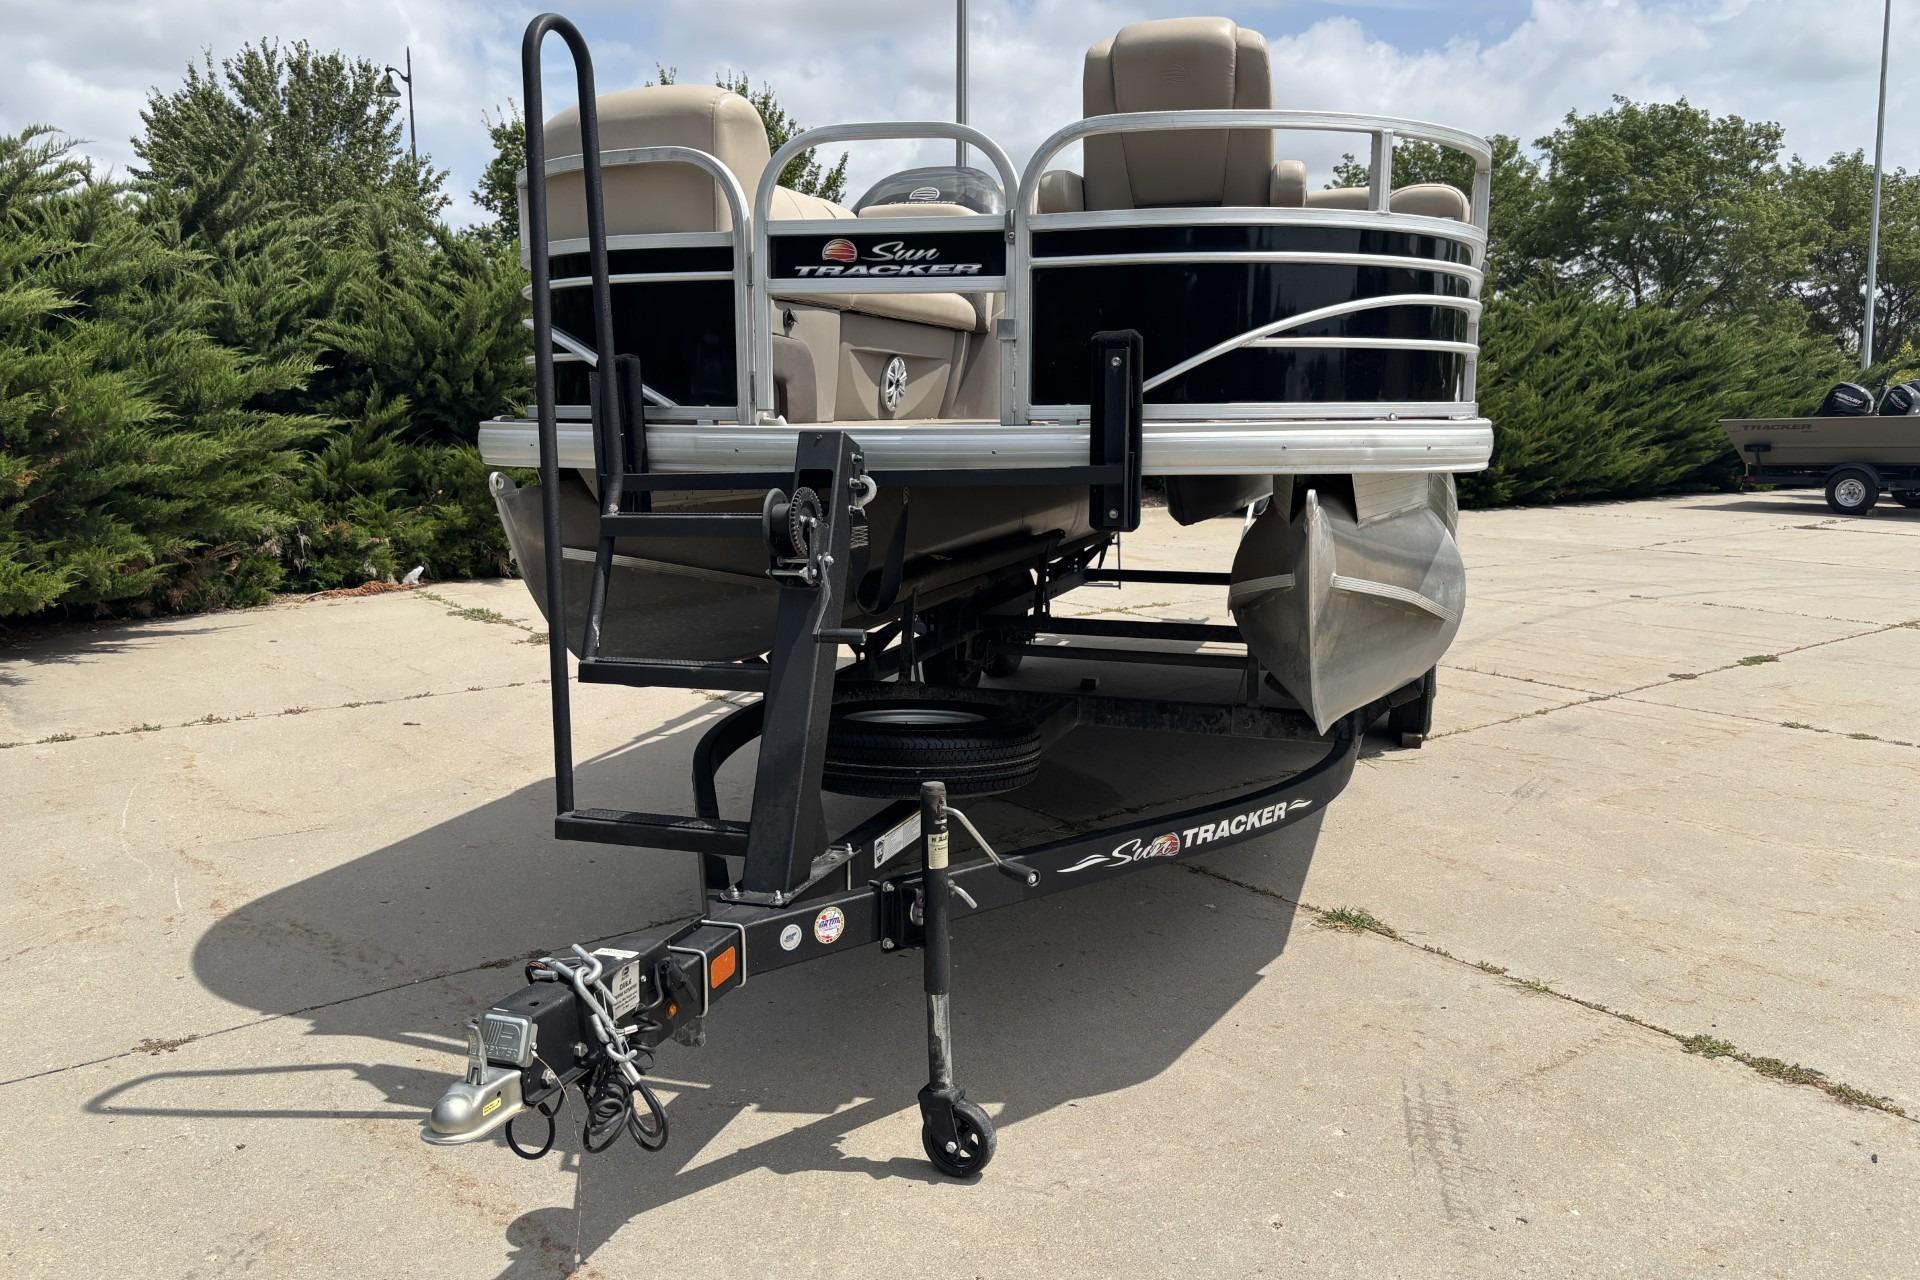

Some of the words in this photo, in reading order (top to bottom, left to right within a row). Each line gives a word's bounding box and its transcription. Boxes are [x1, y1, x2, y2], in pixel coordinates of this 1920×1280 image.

[860, 240, 940, 262] Sun
[794, 263, 983, 277] TRACKER
[1743, 423, 1812, 431] TRACKER
[1103, 838, 1176, 868] Sun
[1182, 801, 1288, 849] TRACKER
